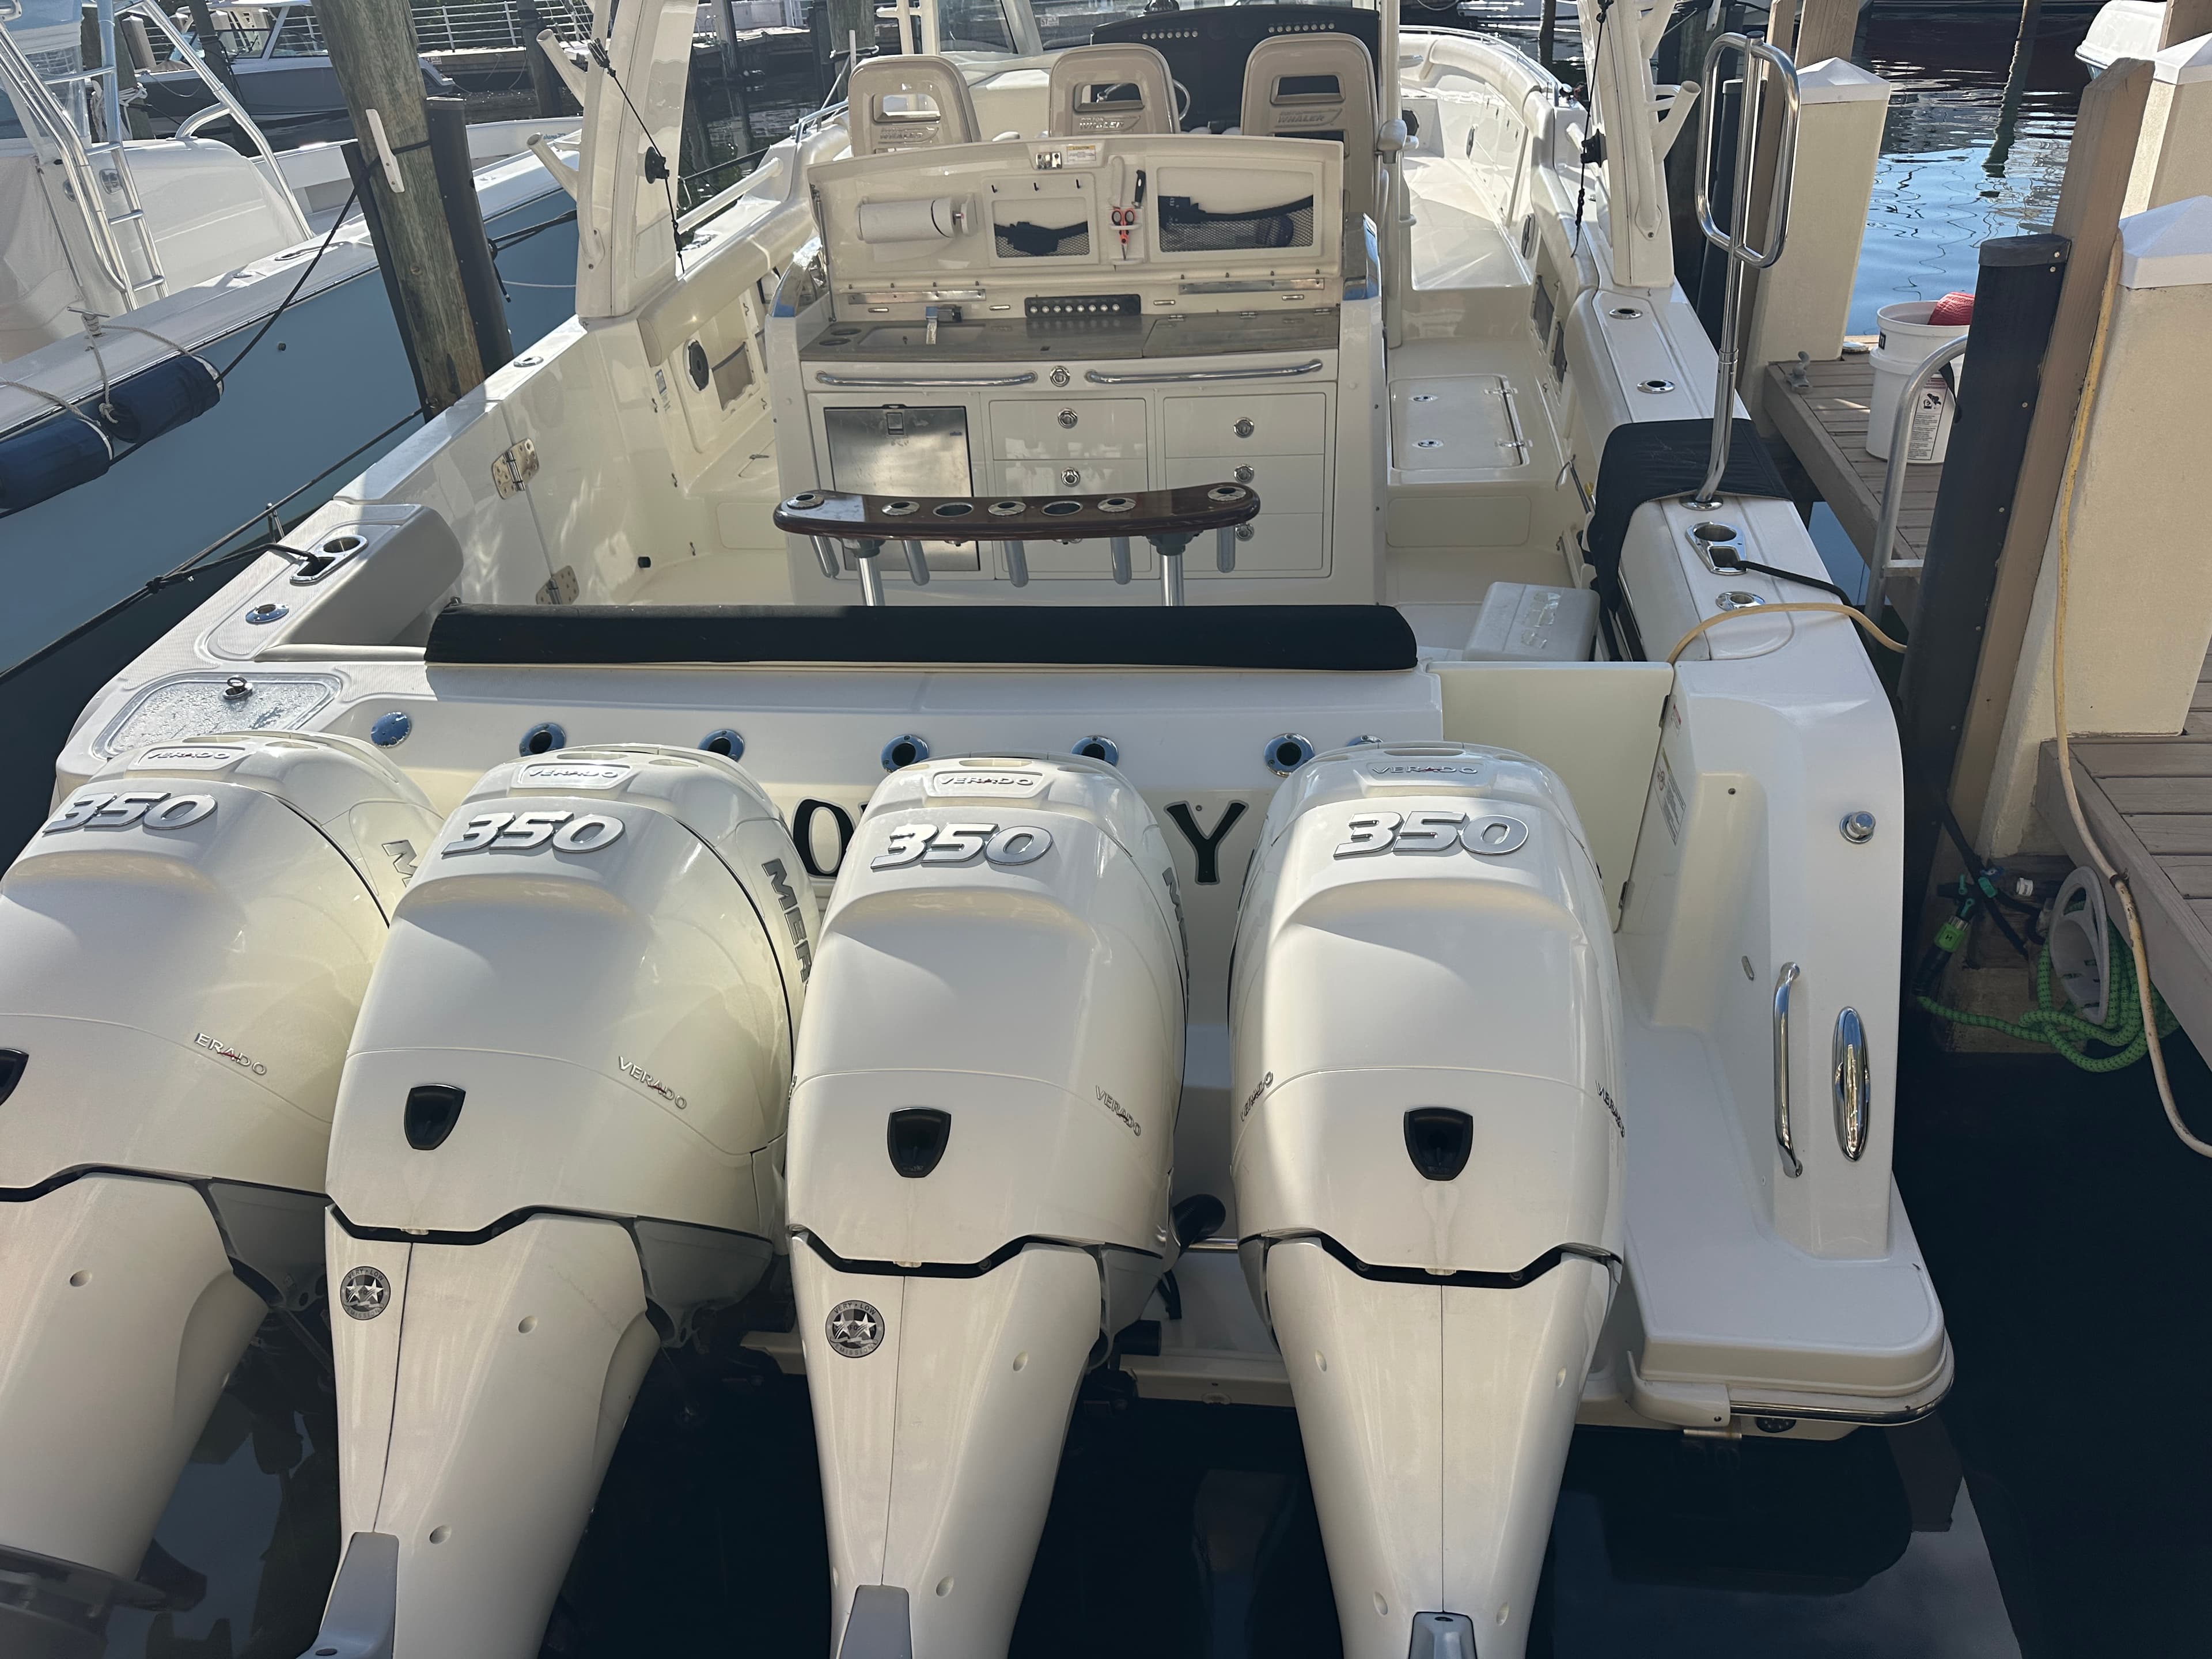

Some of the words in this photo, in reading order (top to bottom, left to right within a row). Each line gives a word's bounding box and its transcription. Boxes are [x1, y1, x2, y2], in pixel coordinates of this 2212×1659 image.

[147, 751, 230, 759] VERADO
[529, 769, 618, 778] VERADO
[940, 777, 1033, 786] VERADO
[42, 791, 218, 833] 350
[441, 810, 626, 855] 350
[870, 823, 1053, 869] 350
[1333, 811, 1529, 858] 350
[194, 1032, 267, 1075] ERADO
[618, 1055, 687, 1109] VERADO
[1240, 1071, 1274, 1122] VERADO
[1096, 1085, 1141, 1137] VERADO
[347, 1268, 363, 1279] VERY
[369, 1270, 384, 1281] LOW
[834, 1302, 853, 1314] VERY
[860, 1302, 876, 1315] LOW
[835, 1343, 874, 1356] EMISSION
